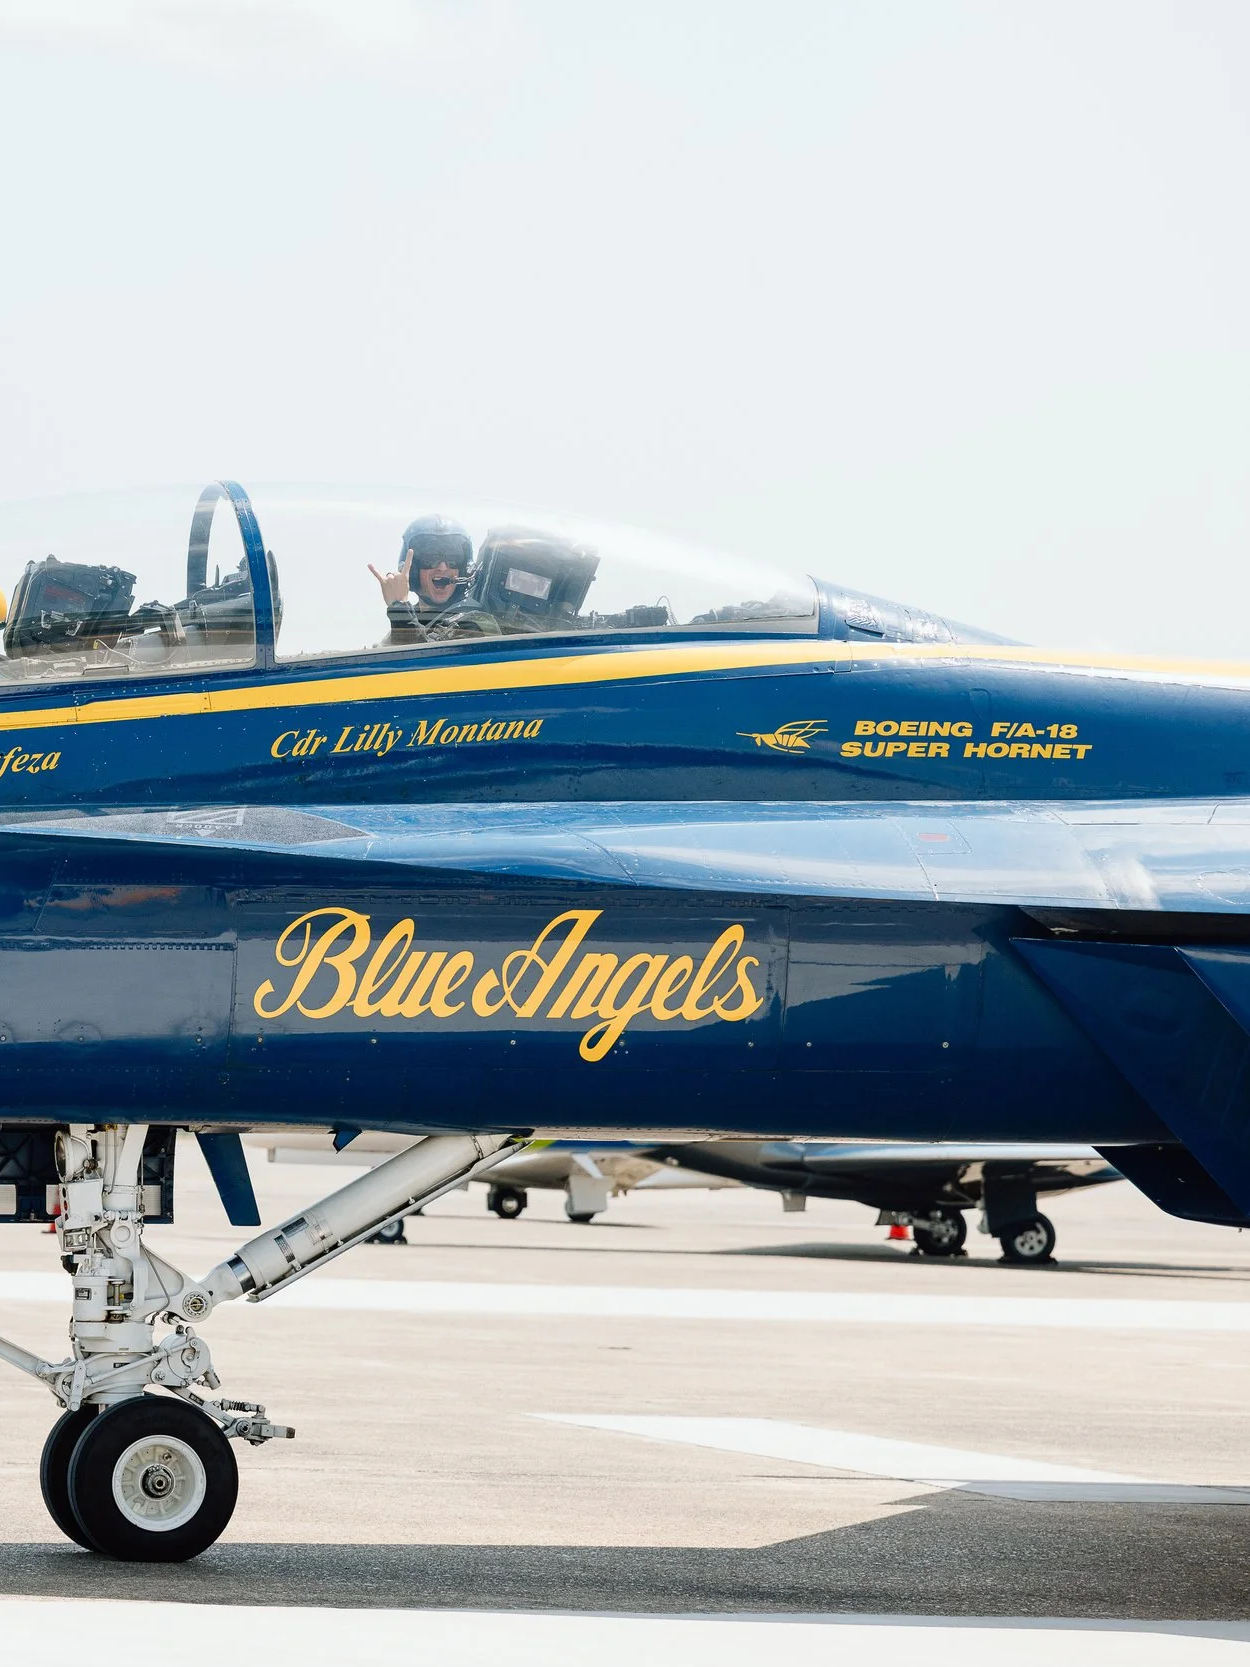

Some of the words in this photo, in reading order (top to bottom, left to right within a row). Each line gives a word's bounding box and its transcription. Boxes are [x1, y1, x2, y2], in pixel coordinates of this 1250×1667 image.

[270, 729, 327, 758] Cdr
[331, 722, 403, 756] Lilly
[406, 718, 543, 746] Montana
[854, 720, 973, 737] BOEING
[991, 722, 1079, 739] F/A-18
[840, 741, 950, 758] SUPER
[963, 742, 1093, 759] HORNET
[253, 906, 475, 1020] Blue
[471, 909, 765, 1062] Angels
